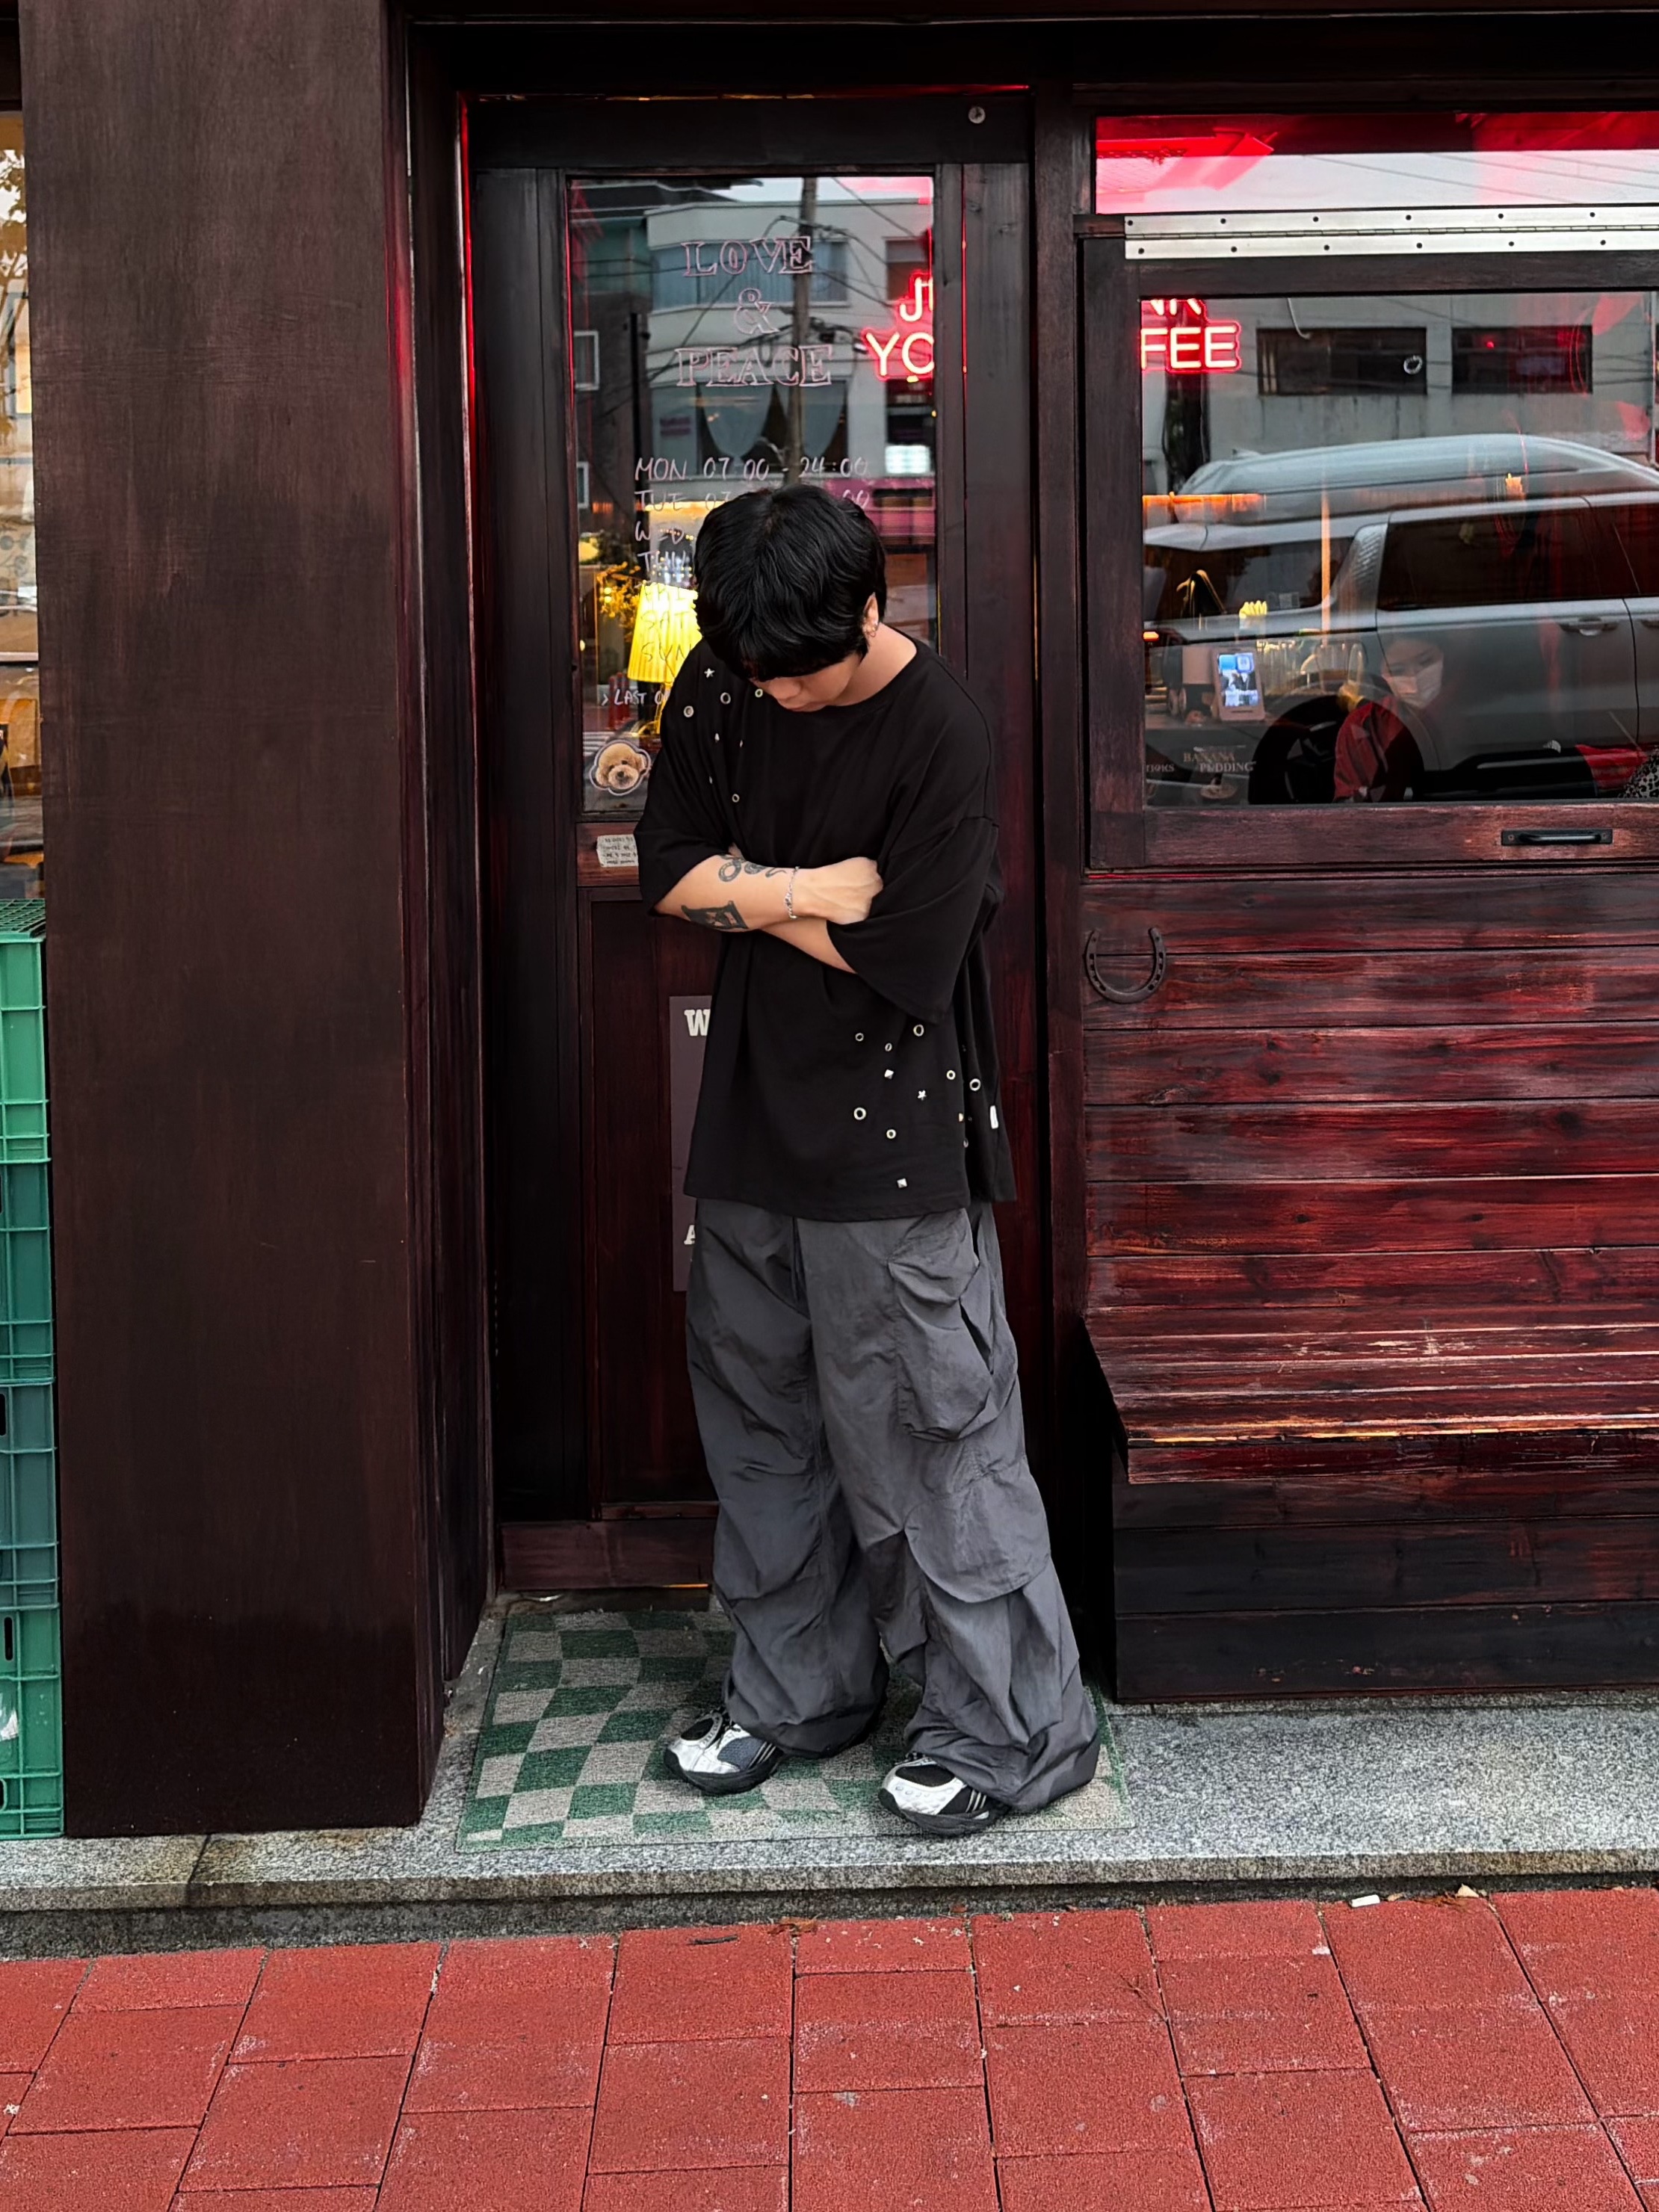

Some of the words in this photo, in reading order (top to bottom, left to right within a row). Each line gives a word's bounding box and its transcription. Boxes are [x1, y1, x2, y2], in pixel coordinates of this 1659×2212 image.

[681, 235, 815, 276] LOVE
[734, 287, 780, 334] &
[674, 344, 833, 387] PEACE
[1140, 326, 1238, 369] FEE
[634, 489, 688, 512] TUE
[614, 688, 648, 706] LAST
